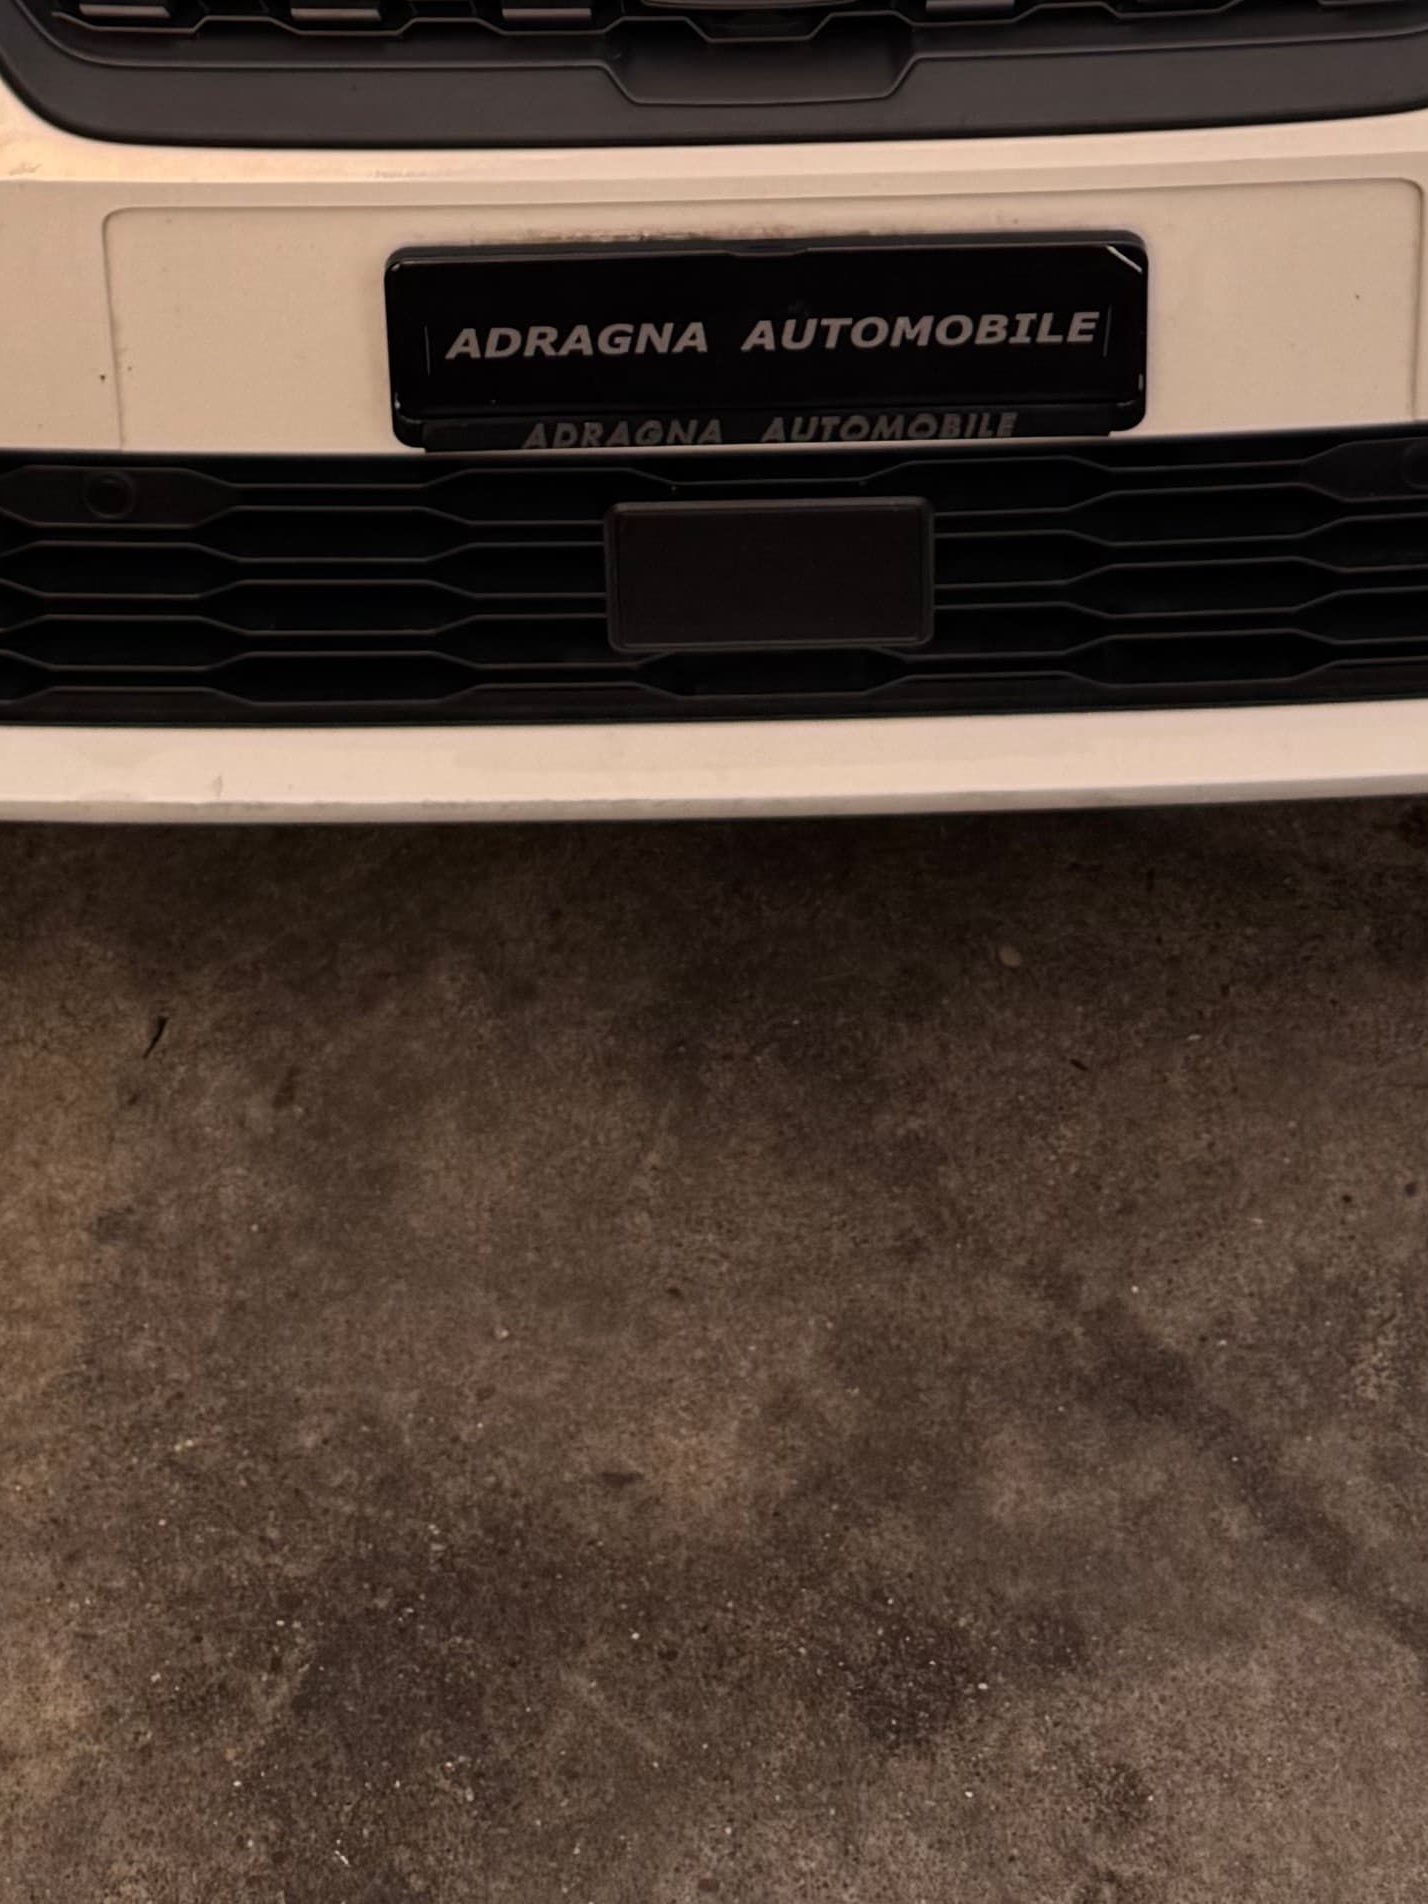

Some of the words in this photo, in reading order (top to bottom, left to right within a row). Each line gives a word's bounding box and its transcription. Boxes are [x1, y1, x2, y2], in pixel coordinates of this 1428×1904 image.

[445, 321, 708, 360] ADRAGNA
[740, 310, 1101, 352] AUTOMOBILE
[522, 418, 723, 450] ADRAGNA
[759, 411, 1019, 444] AUTOMOBILE
